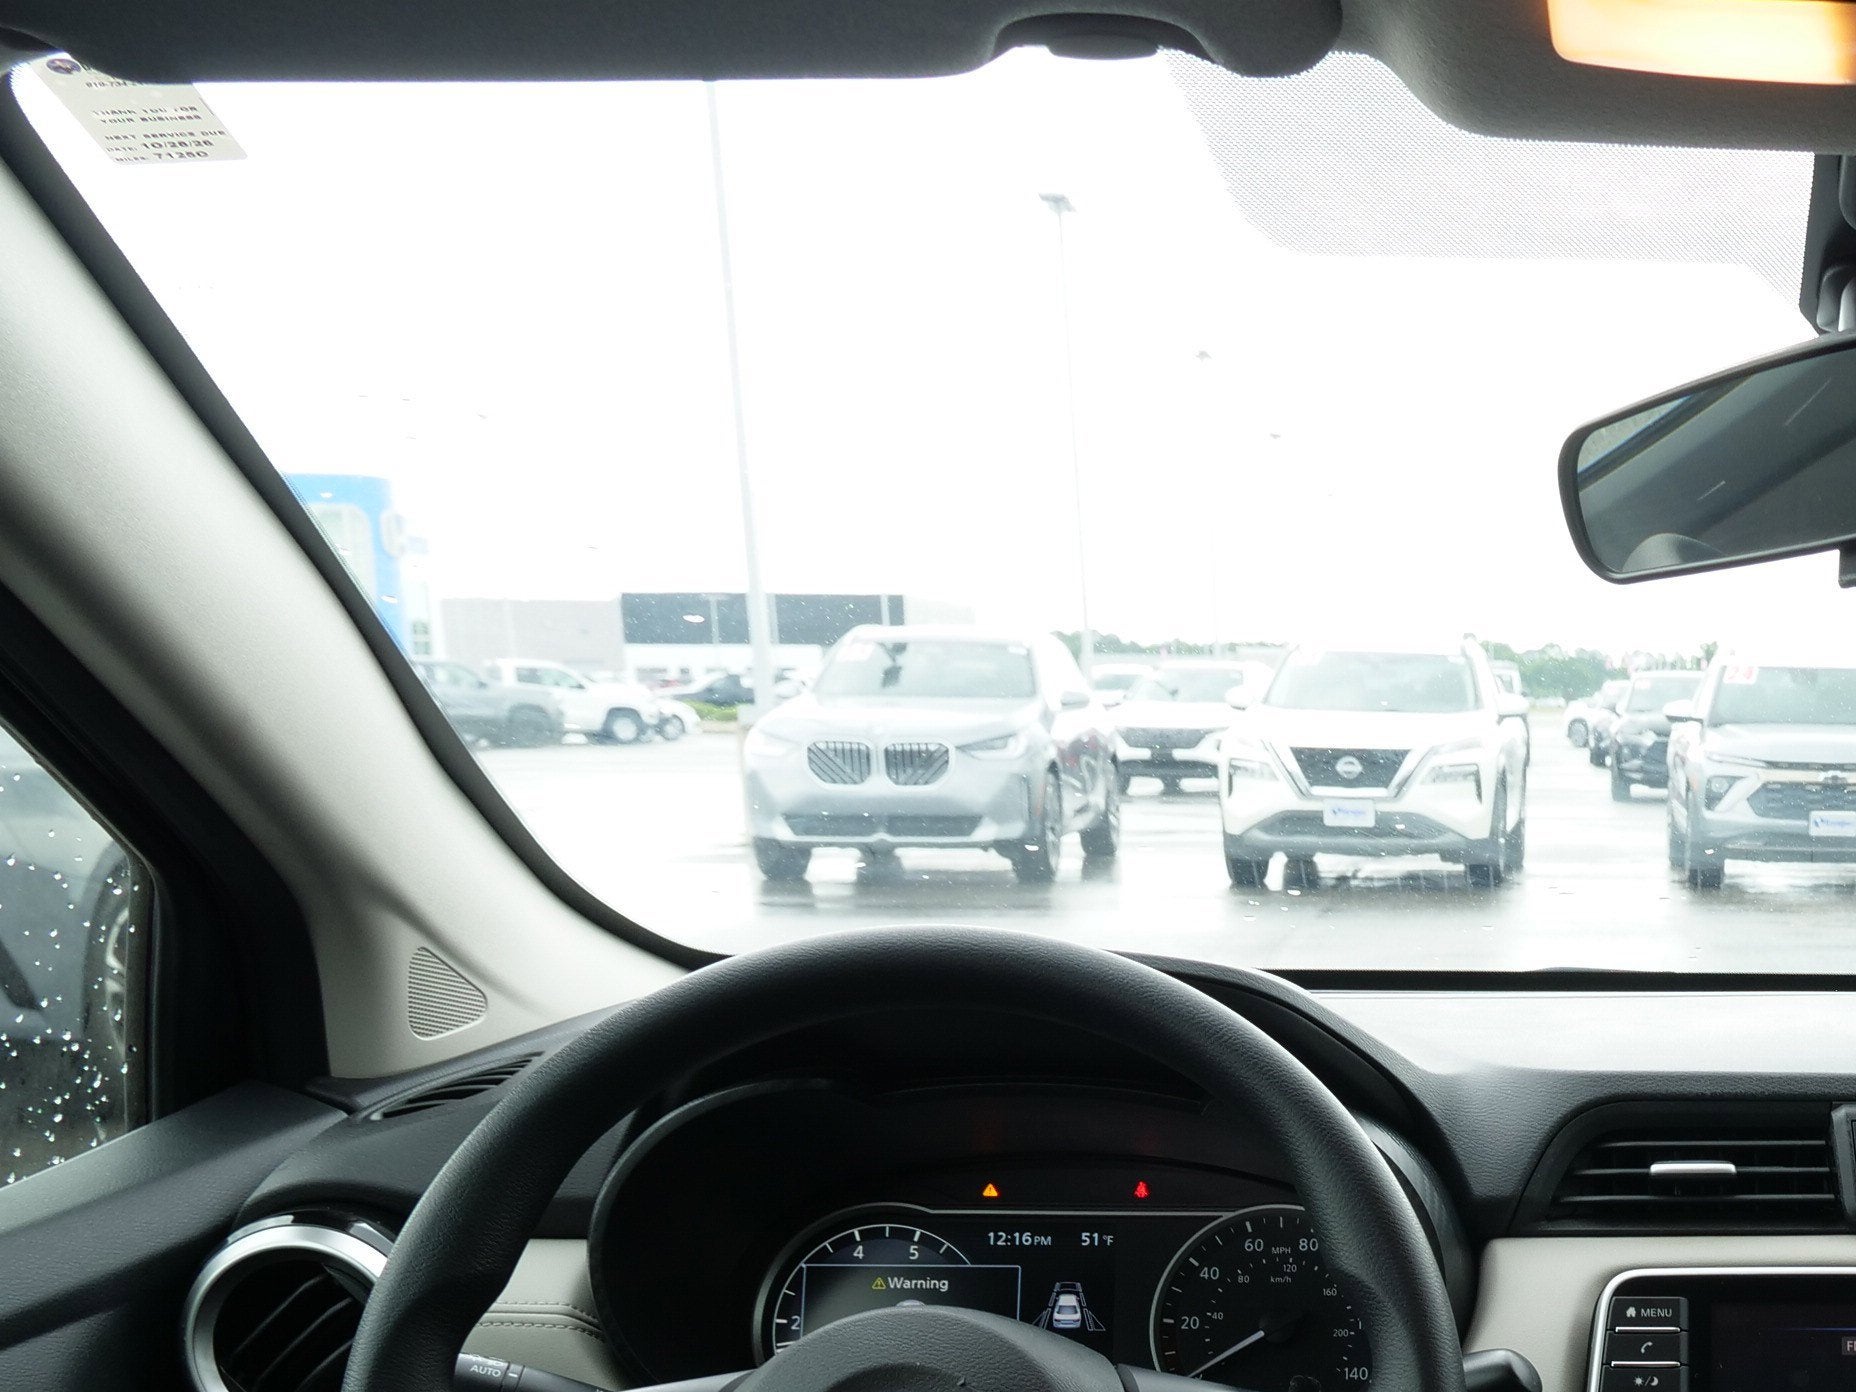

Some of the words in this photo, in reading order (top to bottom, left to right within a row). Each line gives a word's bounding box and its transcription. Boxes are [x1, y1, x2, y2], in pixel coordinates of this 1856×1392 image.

[853, 1245, 865, 1259] 4
[908, 1245, 920, 1259] 5
[1243, 1238, 1265, 1252] 60
[1271, 1245, 1292, 1255] MPH
[1298, 1238, 1320, 1252] 80
[1199, 1266, 1220, 1281] 40
[1282, 1264, 1298, 1273] 120
[887, 1276, 950, 1293] Warning
[1237, 1274, 1250, 1284] 80
[1270, 1275, 1292, 1284] km/h
[1322, 1287, 1338, 1297] 160
[1211, 1311, 1224, 1321] 40
[1640, 1308, 1673, 1318] MENU
[790, 1315, 801, 1331] 2
[1180, 1316, 1200, 1331] 20
[1332, 1328, 1350, 1338] 200
[469, 1363, 502, 1378] AUTO
[1344, 1366, 1370, 1381] 140
